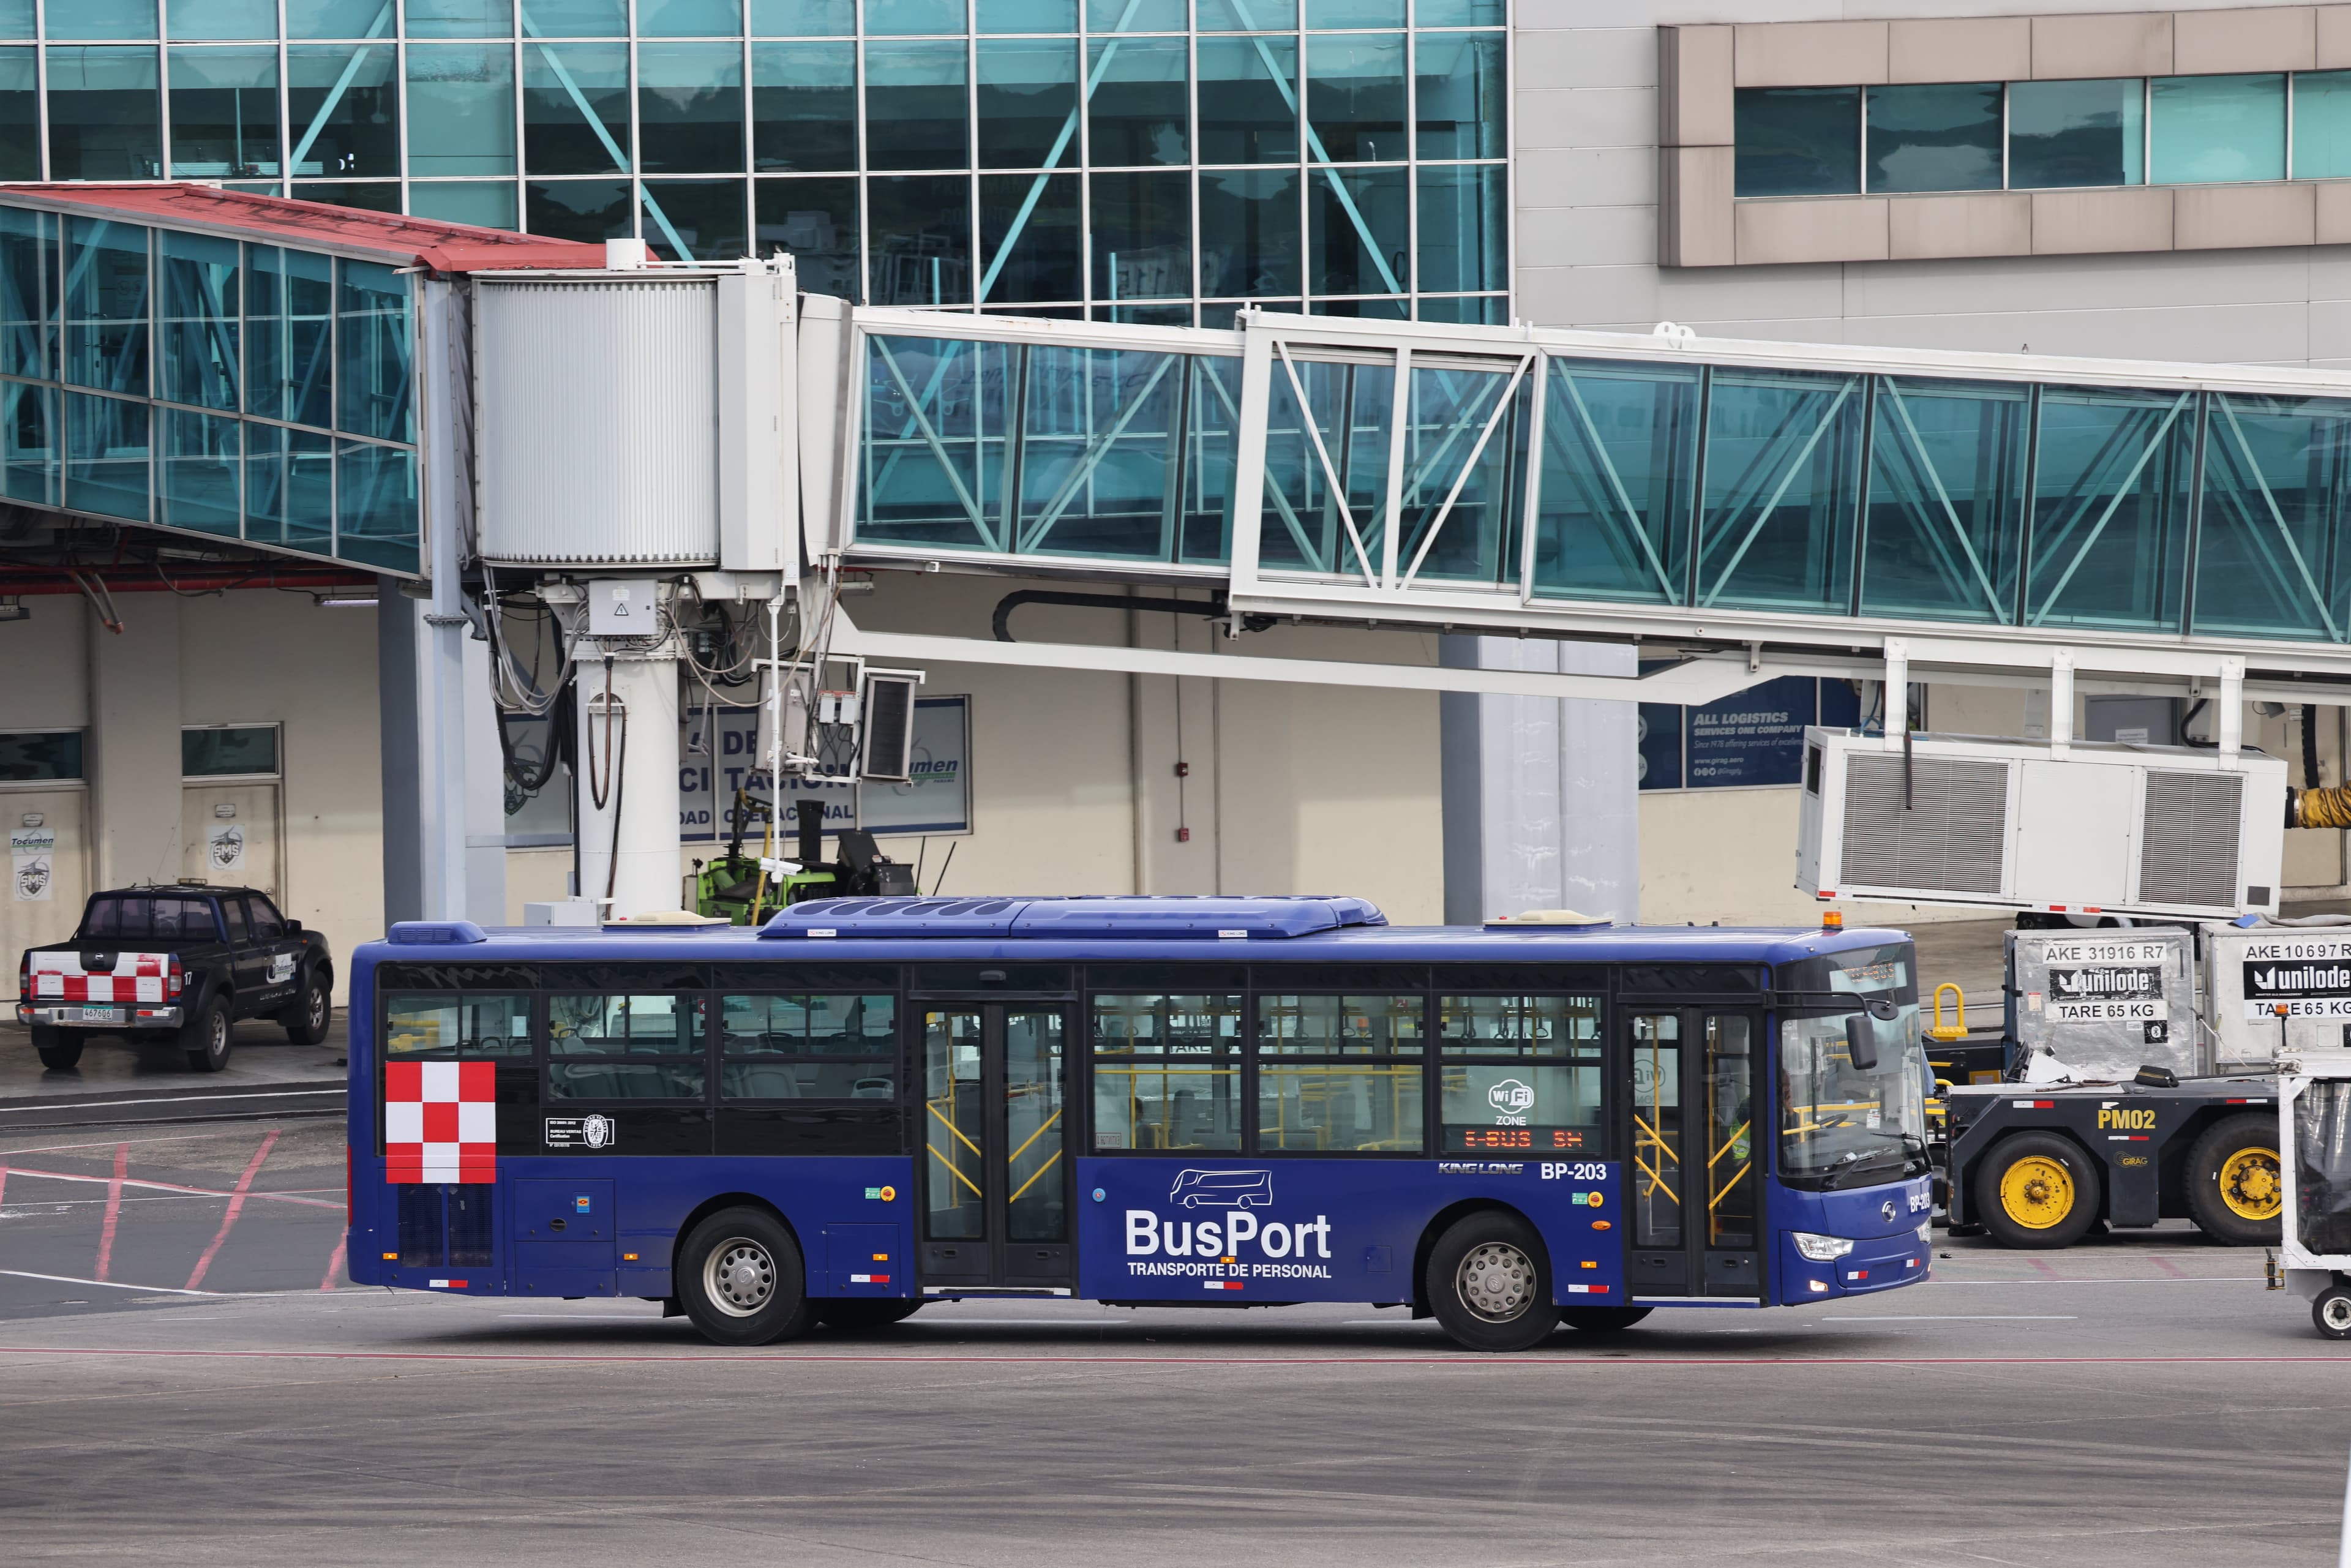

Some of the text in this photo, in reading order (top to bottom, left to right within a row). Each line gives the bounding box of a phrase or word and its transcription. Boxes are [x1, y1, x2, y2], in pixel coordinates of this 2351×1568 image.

[1694, 712, 1788, 726] ALL LOGISTICS
[1694, 725, 1802, 736] SERVICES ONE COMPANY
[1694, 740, 1709, 748] Since
[1748, 738, 1769, 748] services
[214, 844, 240, 857] SMS
[20, 874, 47, 887] SMS
[2046, 945, 2164, 960] AKE 31916 R7
[2246, 945, 2281, 958] AKE
[2285, 944, 2337, 958] 10697
[184, 972, 192, 986] 17
[2082, 969, 2150, 992] unilode
[2278, 966, 2351, 989] unilode
[2059, 1004, 2154, 1018] TARE 65 KG
[2255, 1001, 2351, 1016] TAE 65 KG
[1495, 1116, 1526, 1126] ZONE
[2123, 1157, 2148, 1165] GIRAG
[1438, 1163, 1524, 1175] KING LONG
[1540, 1163, 1607, 1180] BP-203
[1910, 1192, 1930, 1213] BP-203
[1126, 1209, 1332, 1258] BusPort
[1127, 1262, 1332, 1278] TRANSPORTE DE PERSONAL
